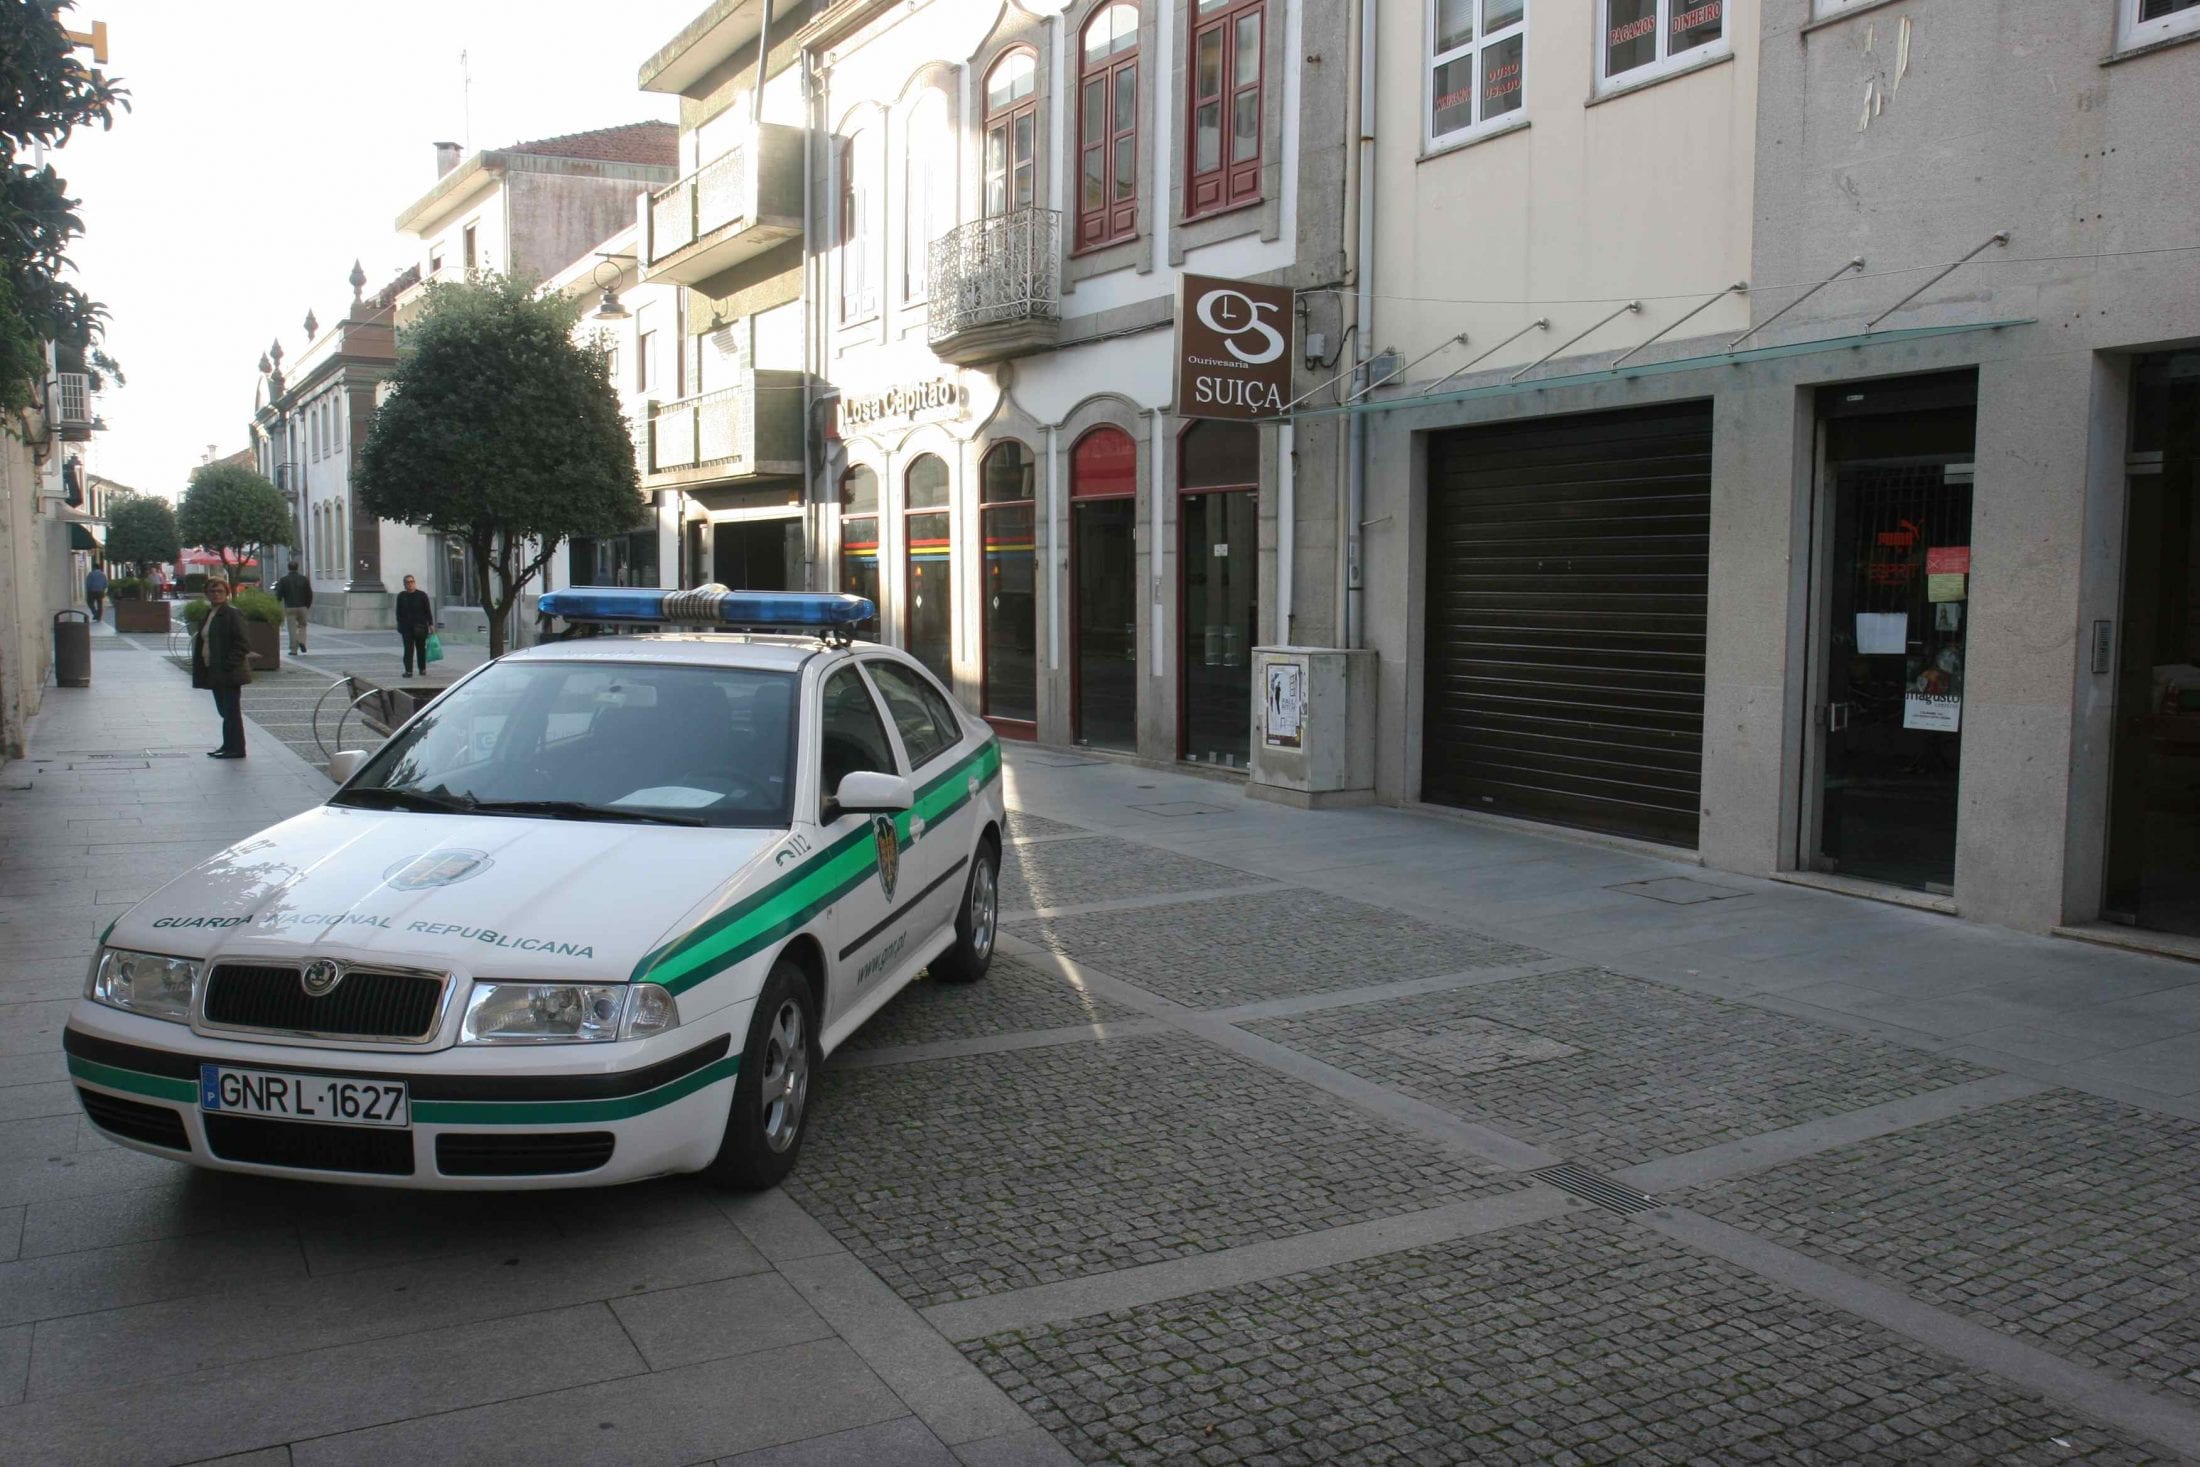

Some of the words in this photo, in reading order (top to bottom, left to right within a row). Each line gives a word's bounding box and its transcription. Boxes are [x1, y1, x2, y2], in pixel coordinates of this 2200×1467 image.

[1609, 15, 1656, 47] PAGAMOS
[1672, 1, 1721, 34] DINHEIRO
[1485, 77, 1522, 100] USADO
[1489, 63, 1520, 82] OURO
[1188, 355, 1249, 369] Ourivesaria
[843, 398, 882, 424] Losa
[884, 375, 952, 421] Capitão
[1195, 376, 1283, 413] SUIÇA
[789, 834, 812, 856] 112
[152, 914, 254, 928] GUARDA
[264, 912, 393, 929] NACIONAL
[405, 920, 595, 959] REPUBLICANA
[208, 1092, 215, 1102] P
[220, 1073, 288, 1113] GNR
